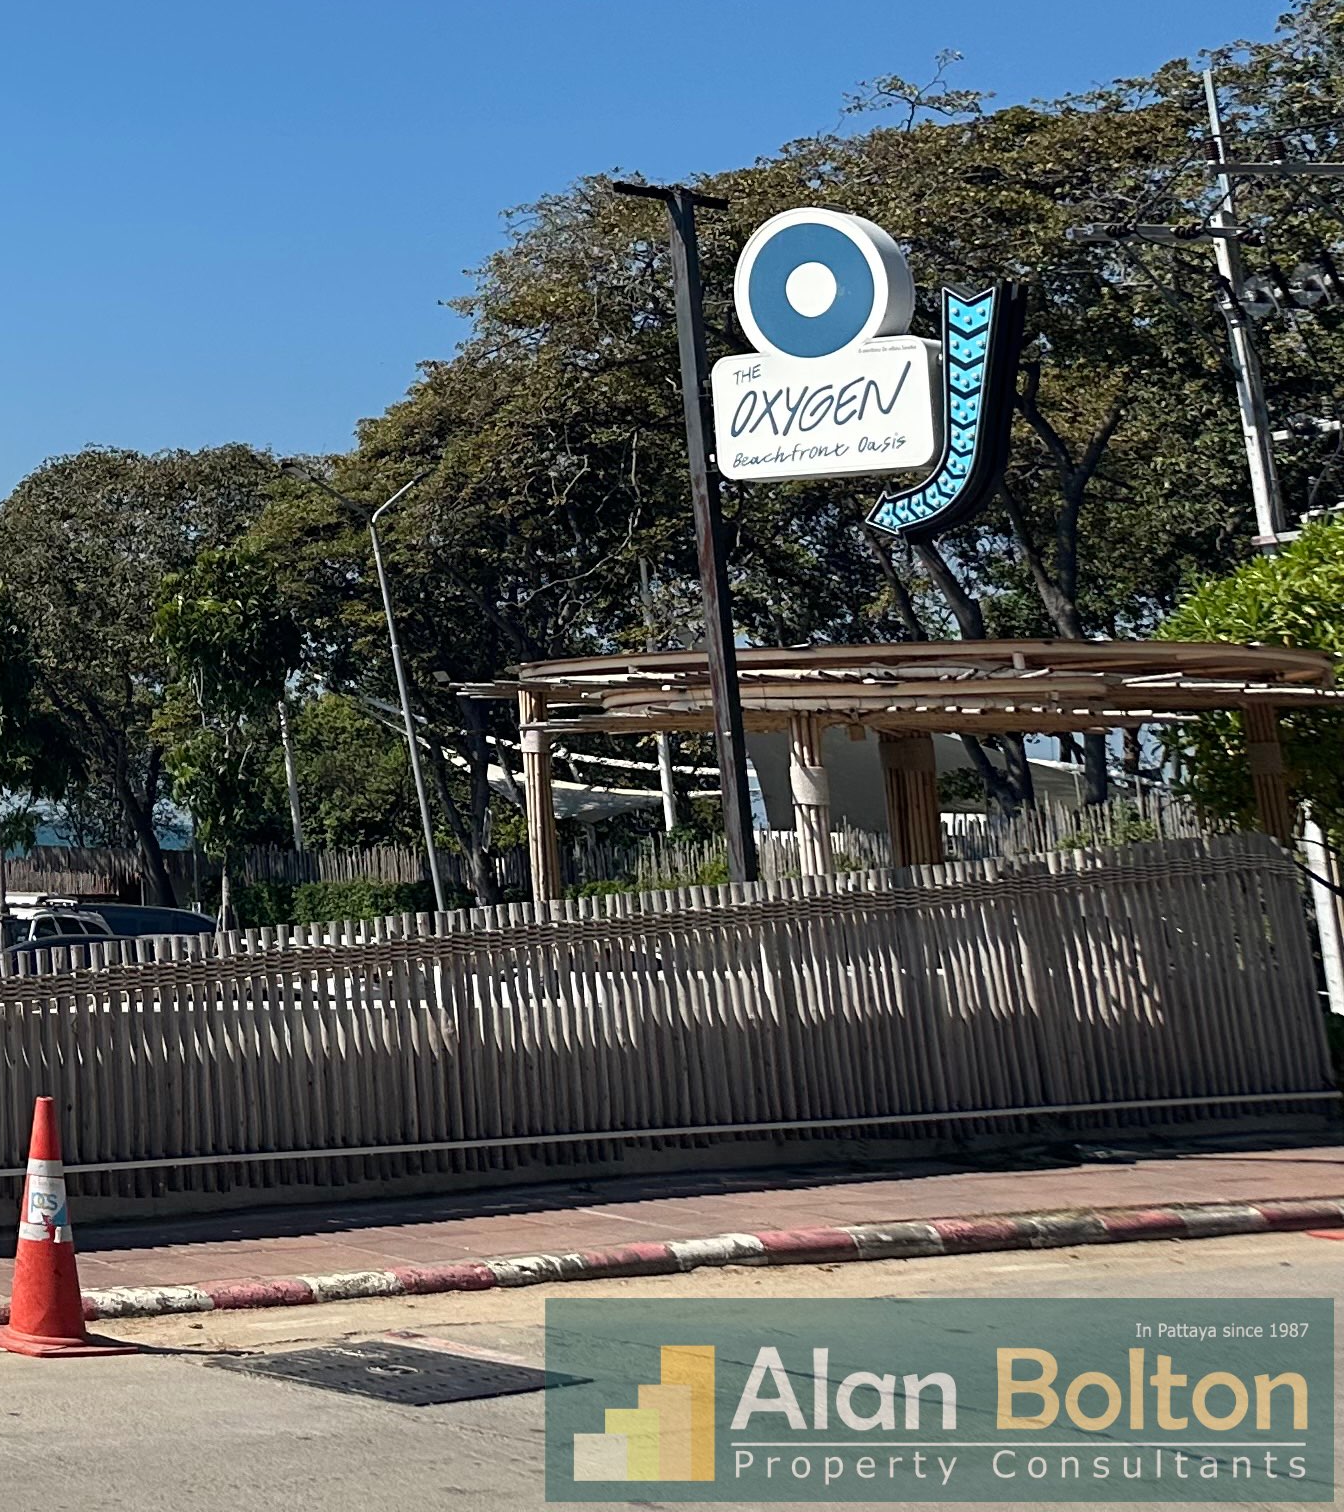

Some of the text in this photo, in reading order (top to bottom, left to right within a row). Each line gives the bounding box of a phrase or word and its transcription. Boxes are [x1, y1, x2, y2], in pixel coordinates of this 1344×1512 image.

[733, 364, 762, 385] THE
[730, 360, 912, 438] OXYGEN
[732, 431, 907, 469] Beachfront Oasis
